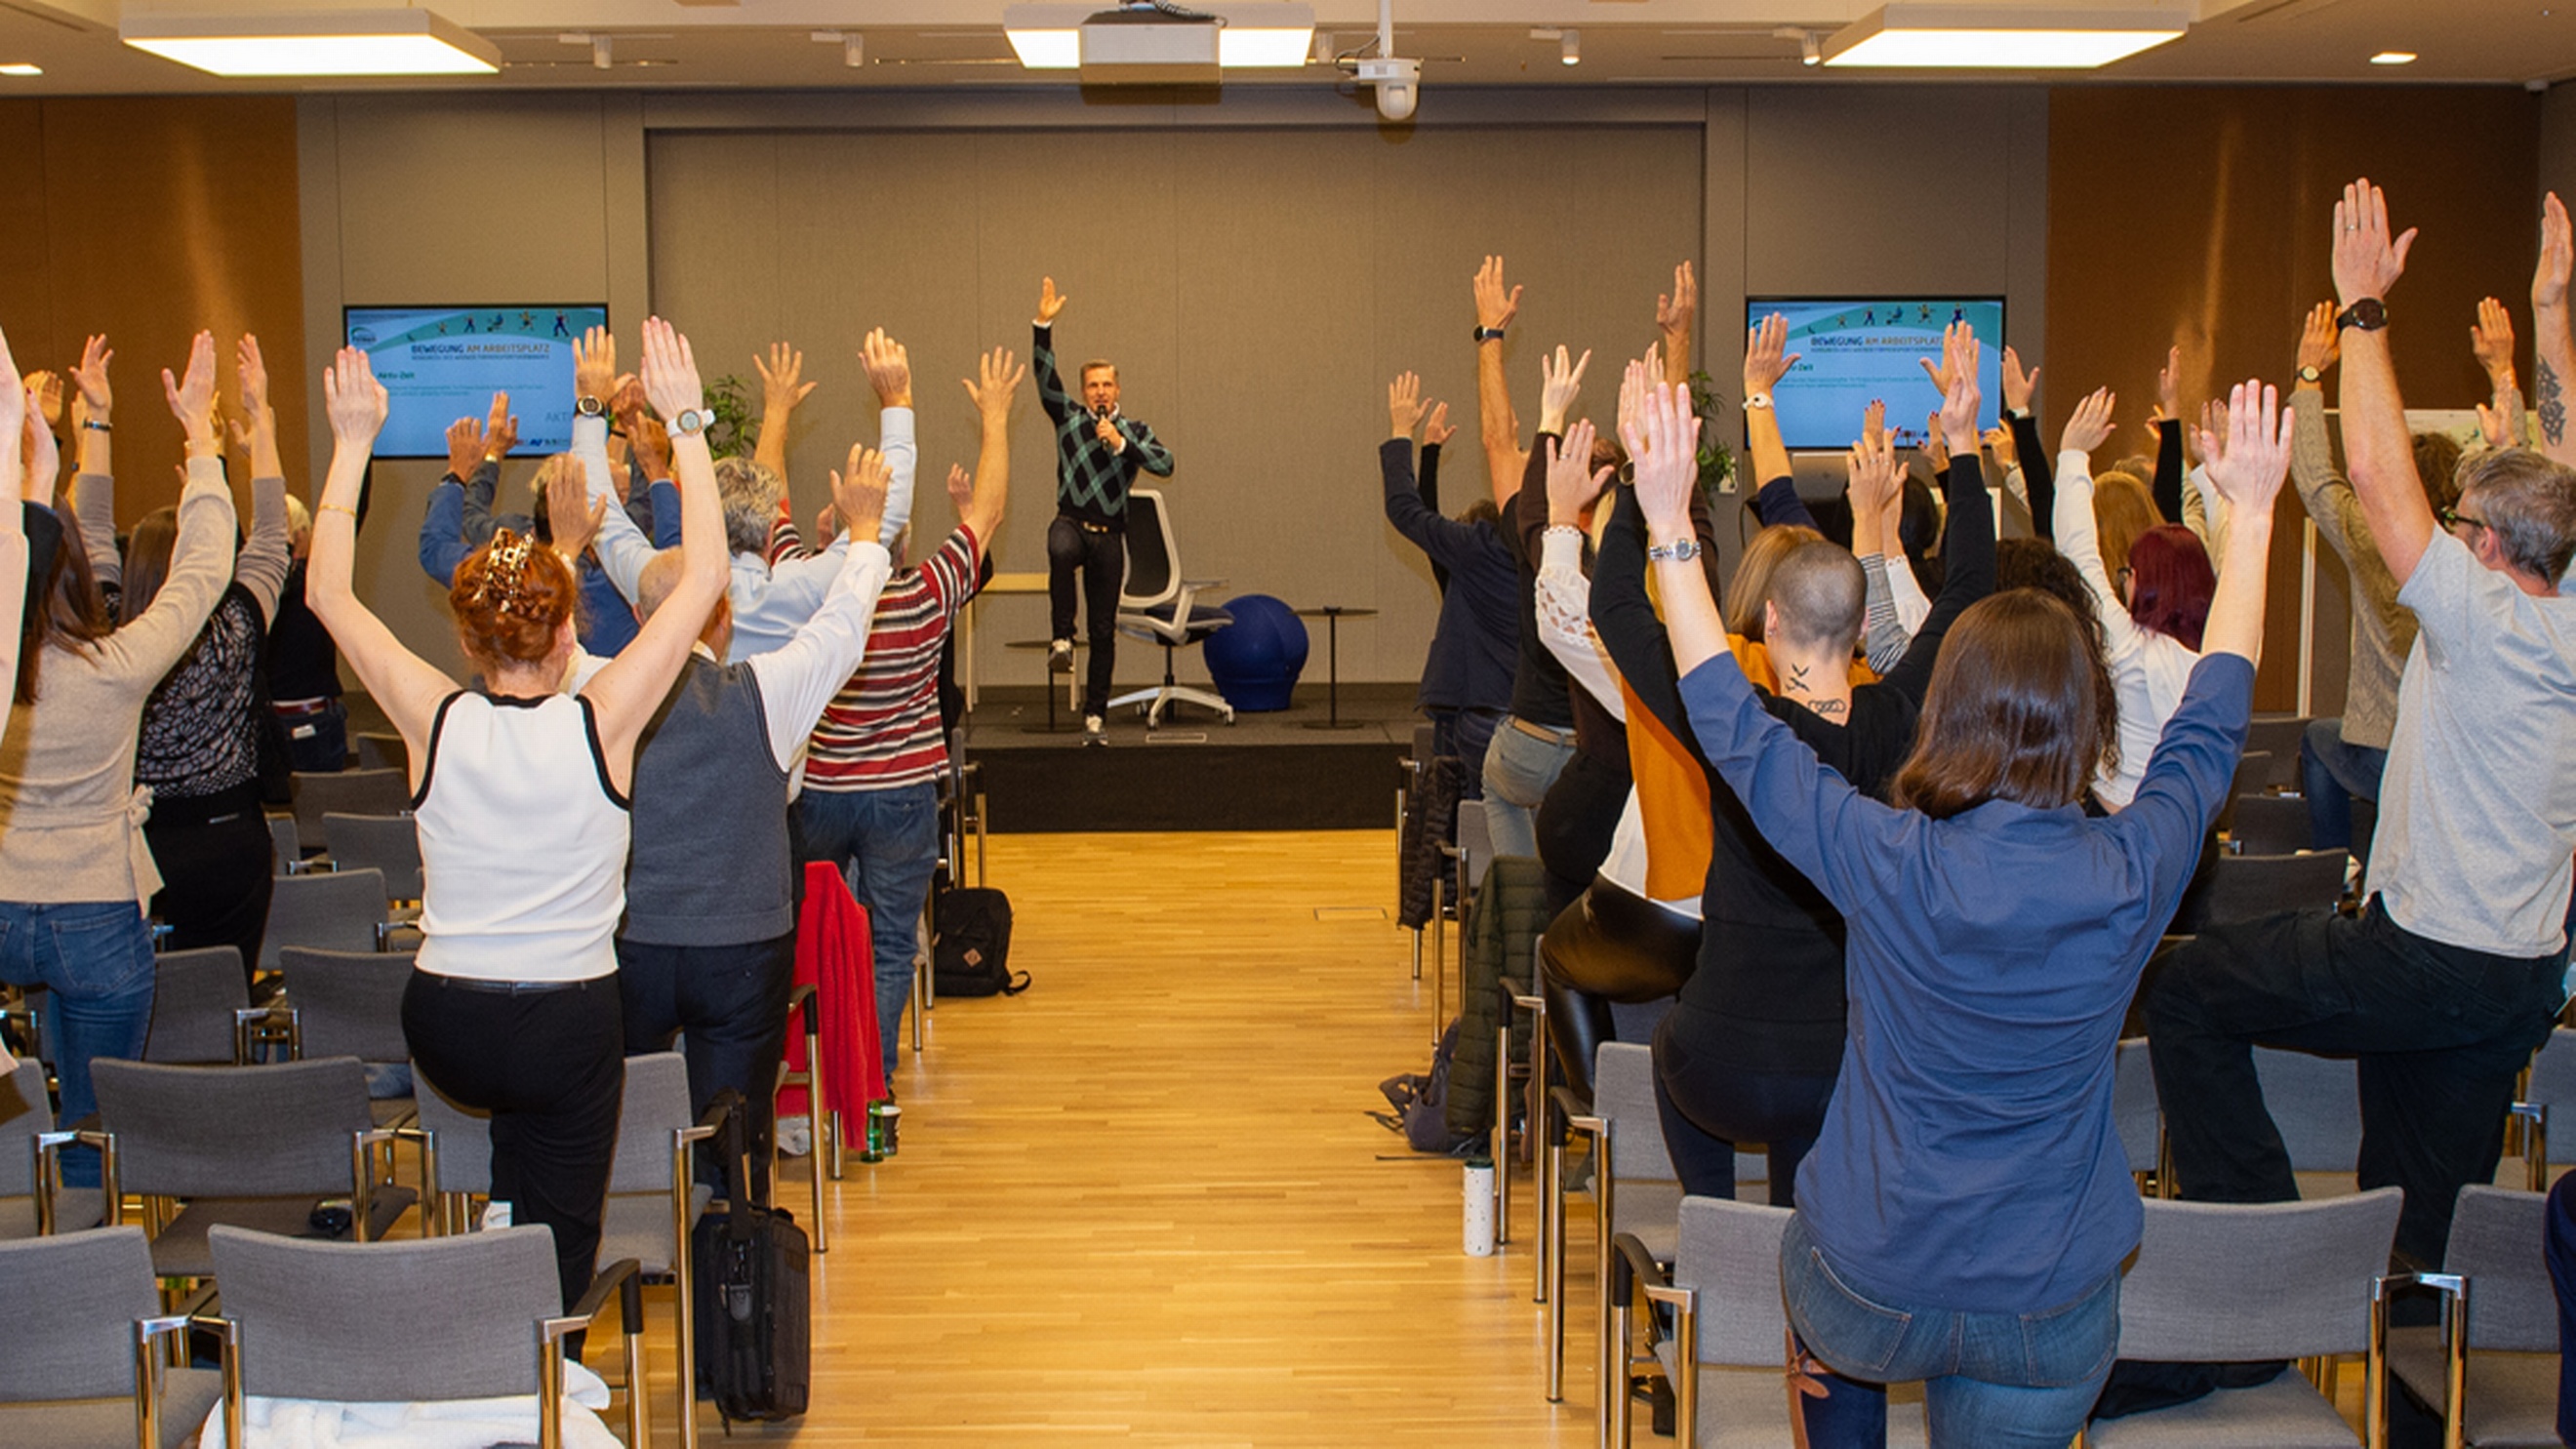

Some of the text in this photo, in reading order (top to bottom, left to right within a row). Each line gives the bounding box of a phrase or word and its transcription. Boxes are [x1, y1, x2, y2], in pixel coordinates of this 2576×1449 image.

[1810, 337, 1864, 345] BEWEGUNG
[1865, 337, 1879, 345] AM
[411, 343, 550, 353] BEWEGUNG AM ARBEITSPLATZ
